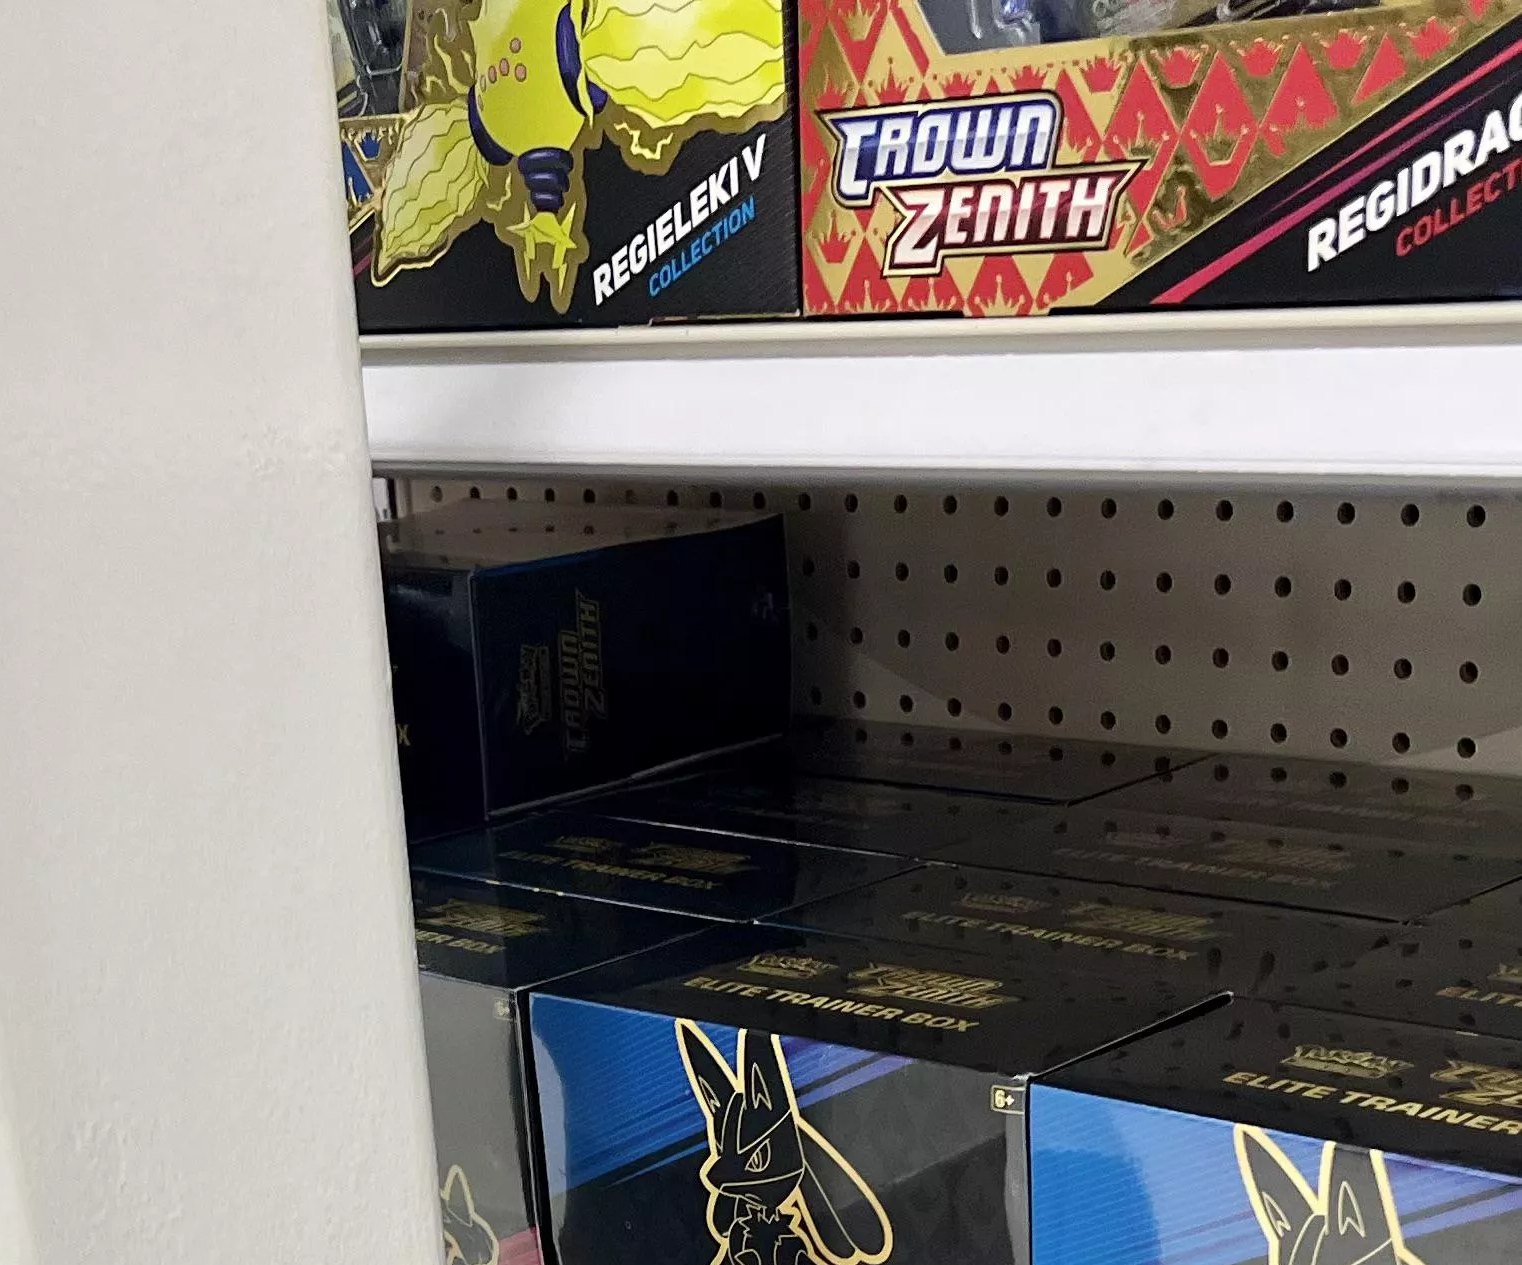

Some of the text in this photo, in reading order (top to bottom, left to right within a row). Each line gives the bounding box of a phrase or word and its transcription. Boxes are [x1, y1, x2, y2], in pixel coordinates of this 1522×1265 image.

[836, 101, 1056, 198] CROWN
[593, 133, 766, 306] REGIELEKI V
[648, 195, 756, 297] COLLECTION
[891, 175, 1118, 266] ZENITH
[683, 975, 981, 1033] ELITE TRAINER BOX
[994, 1089, 1015, 1108] 6+
[1222, 1071, 1522, 1136] ELITE TRAINER
